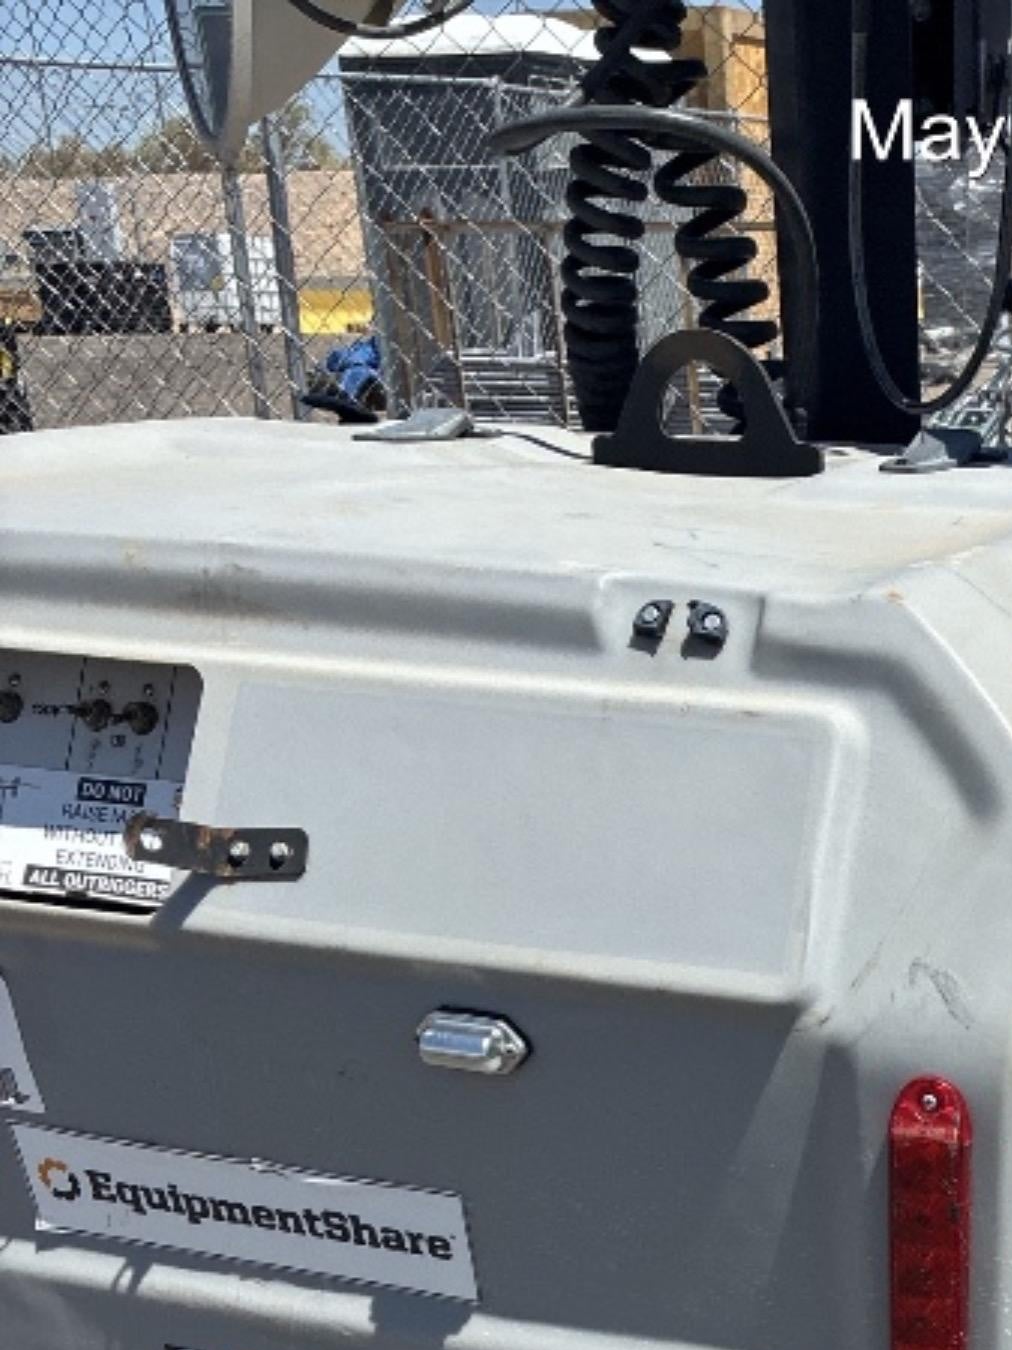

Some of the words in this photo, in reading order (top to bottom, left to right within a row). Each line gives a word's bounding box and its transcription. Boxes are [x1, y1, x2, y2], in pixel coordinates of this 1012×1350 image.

[83, 783, 105, 798] DO
[109, 785, 141, 803] NOT
[62, 804, 108, 822] RAISE
[29, 869, 60, 885] ALL
[64, 872, 170, 899] OUTRIGGERS
[84, 1168, 456, 1261] EquipmentShare
